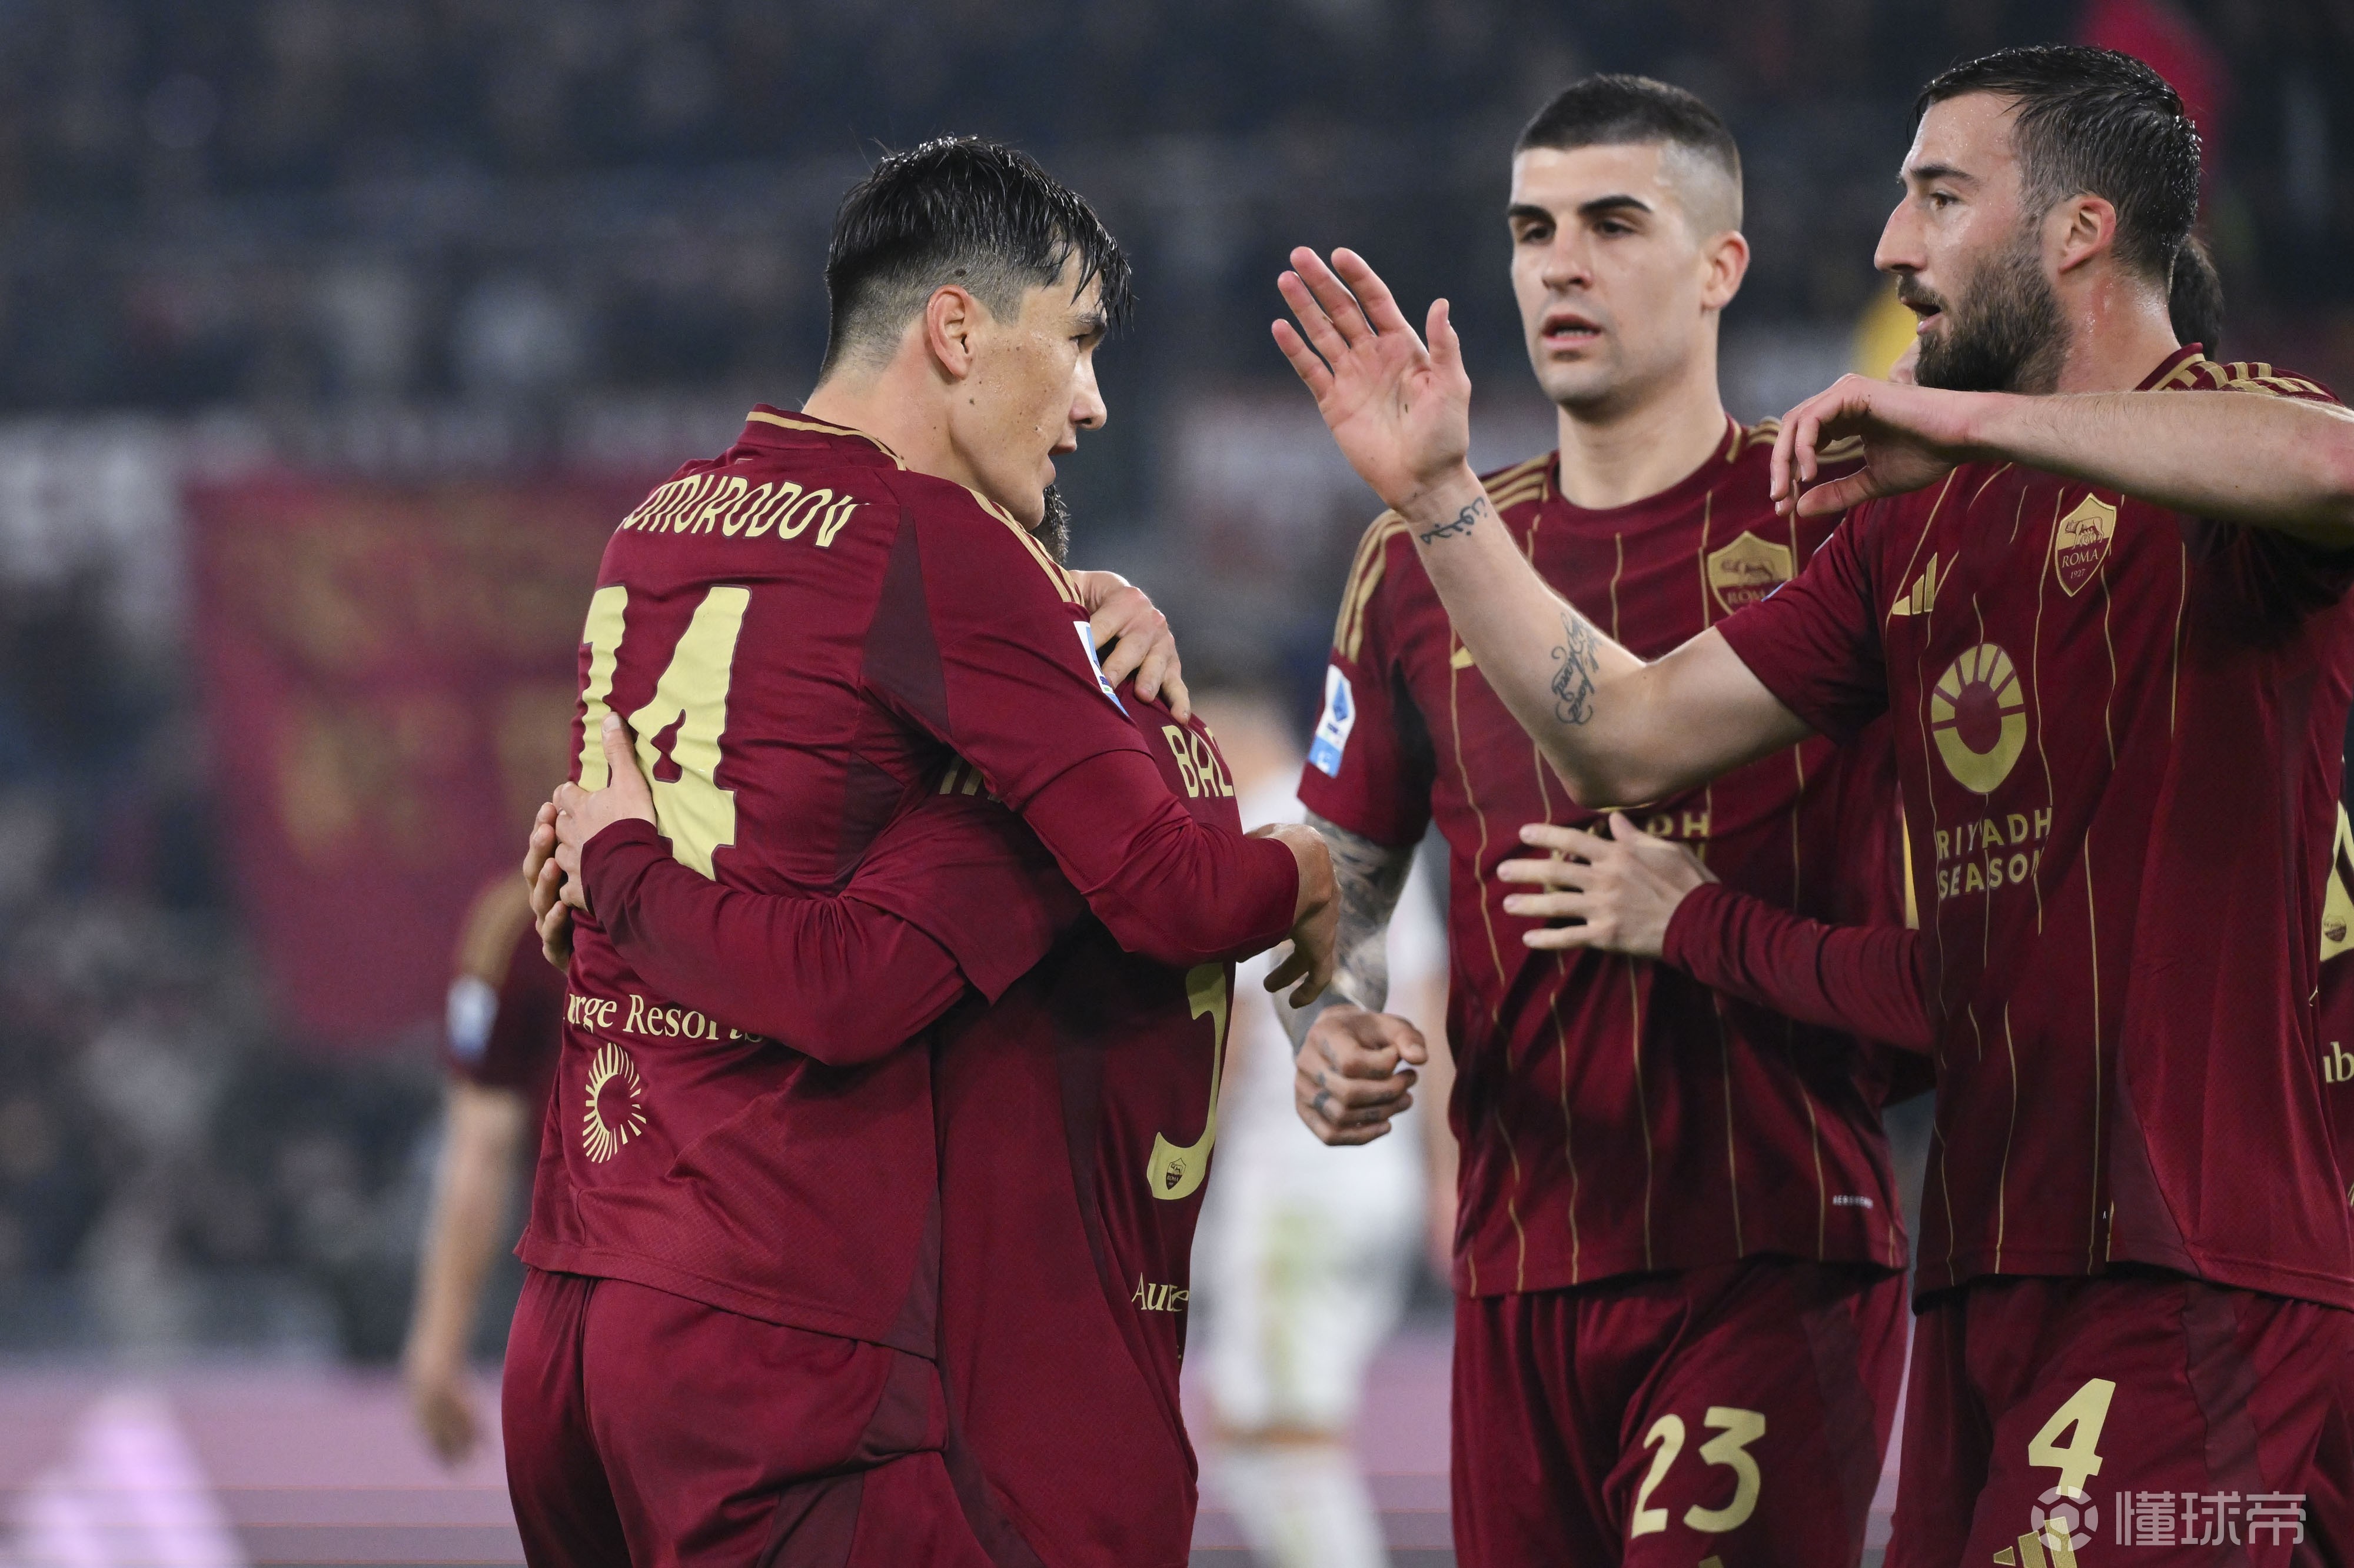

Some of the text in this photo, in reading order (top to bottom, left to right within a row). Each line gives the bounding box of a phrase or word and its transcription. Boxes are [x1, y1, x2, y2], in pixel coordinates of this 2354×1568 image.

[2062, 548, 2099, 568] ROMA
[2070, 568, 2086, 580] 1927
[583, 585, 752, 881] 14
[1161, 721, 1234, 798] BAL
[1936, 807, 2052, 862] RIYADH
[1631, 1406, 1766, 1539] 23
[2028, 1377, 2116, 1499] 4
